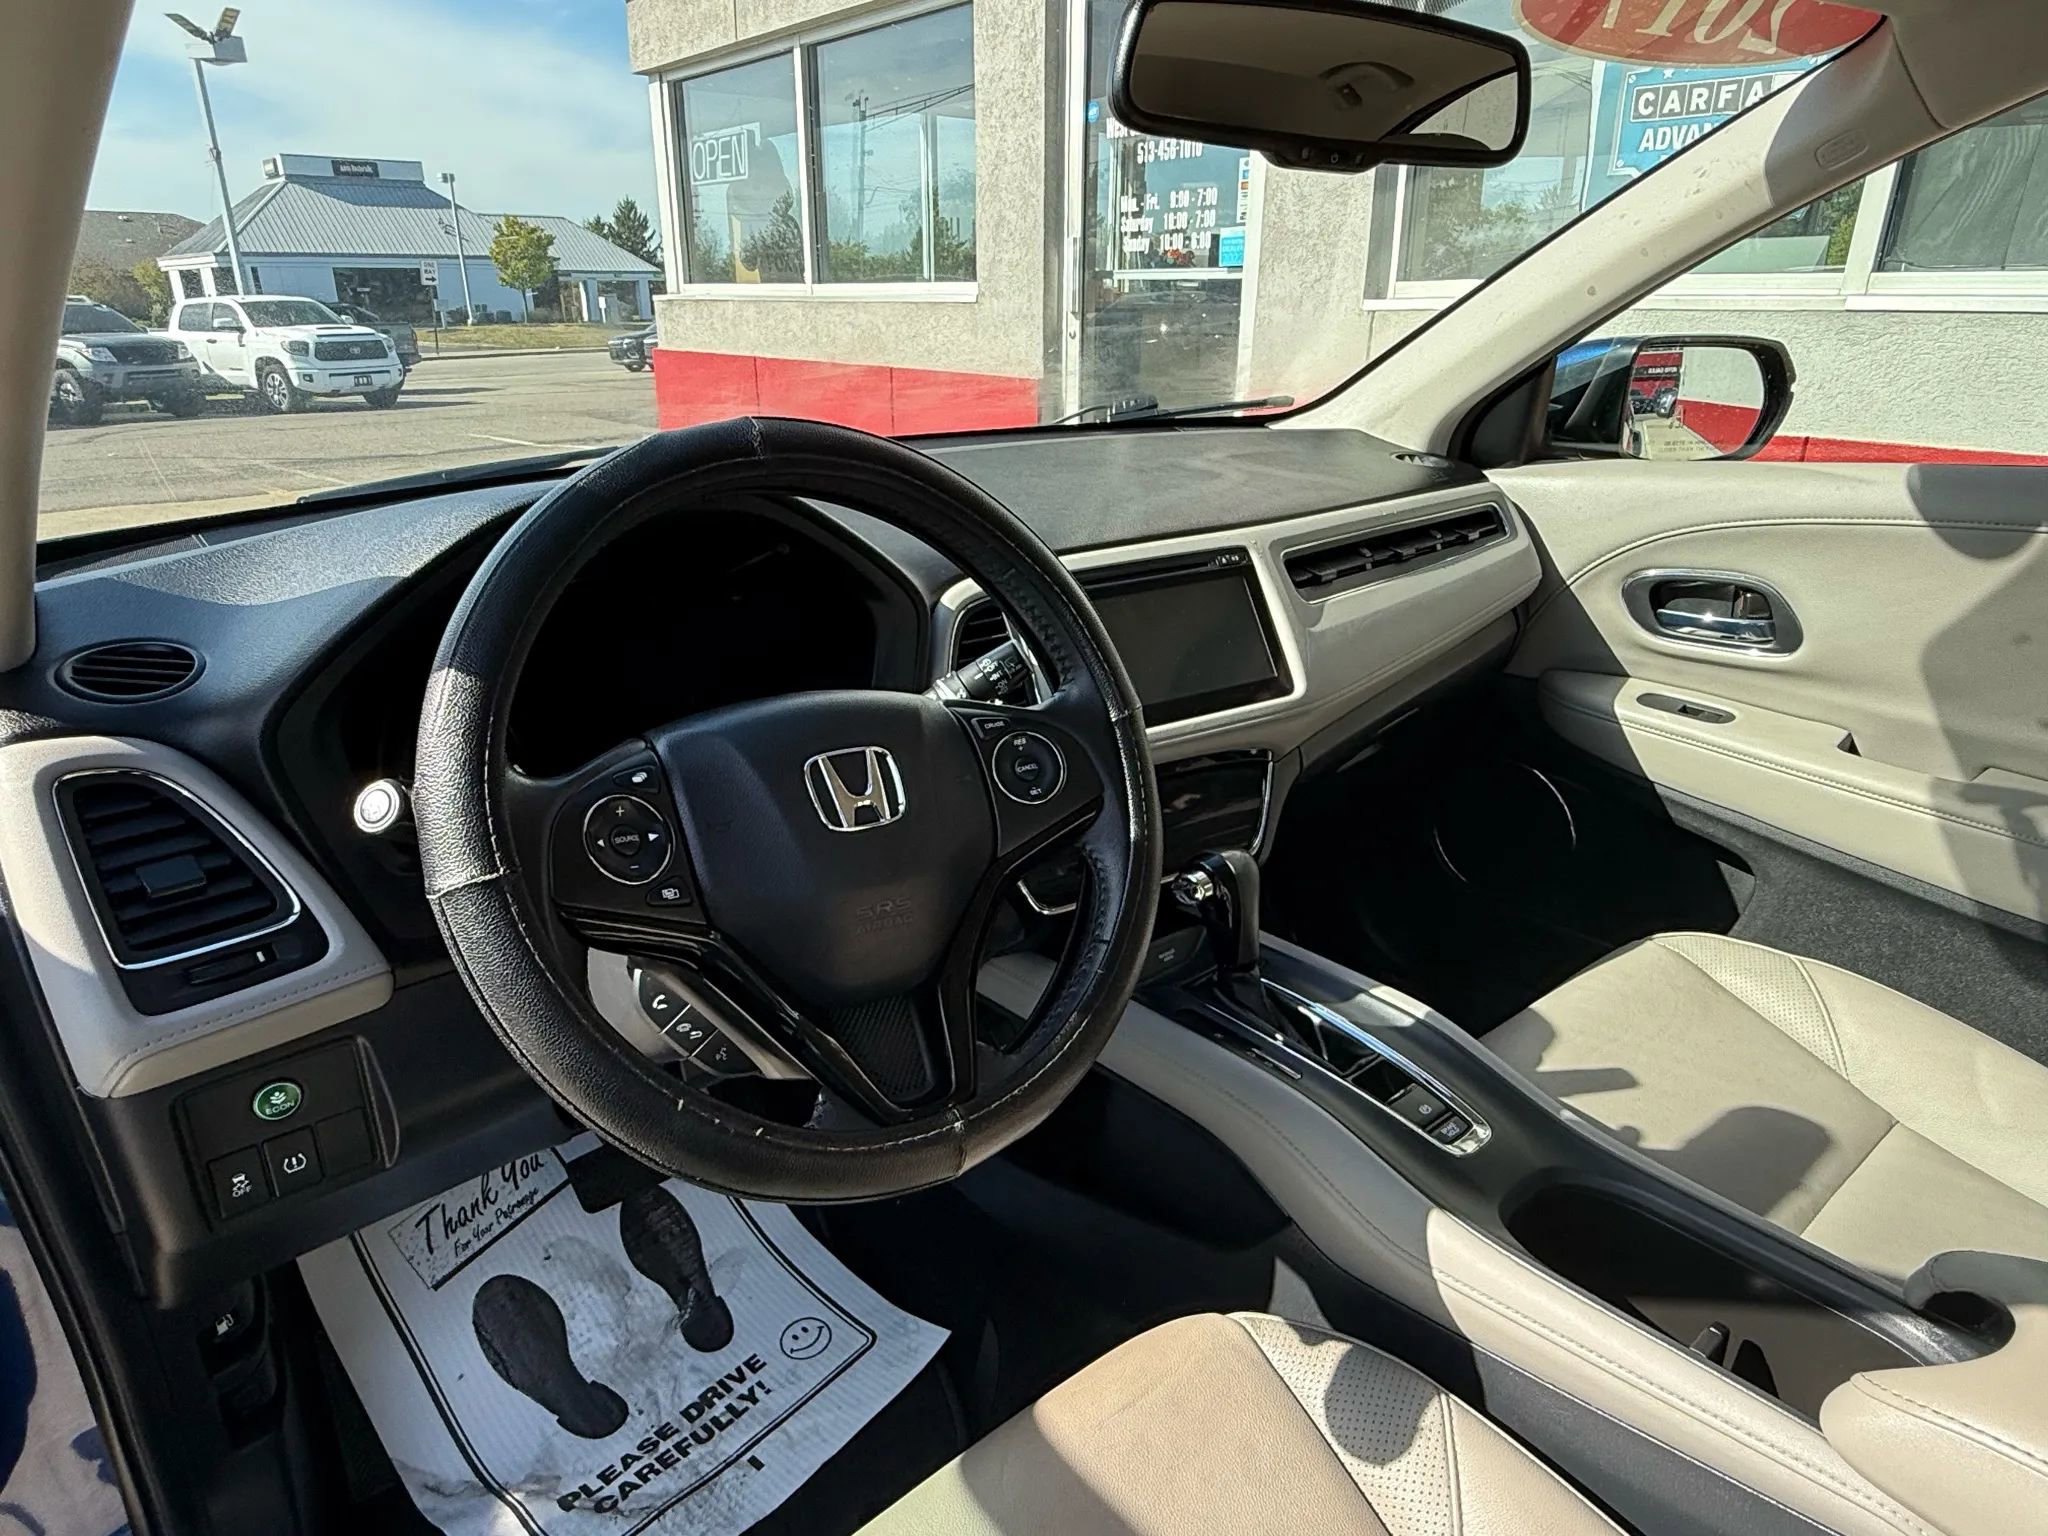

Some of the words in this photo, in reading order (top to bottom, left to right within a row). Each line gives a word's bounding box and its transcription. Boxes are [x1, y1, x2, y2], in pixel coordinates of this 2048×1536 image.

[1638, 80, 1766, 116] CARFA
[693, 133, 745, 180] OPEN
[1196, 187, 1218, 207] 7:00
[1164, 211, 1188, 230] 10:00
[1195, 209, 1216, 229] 7:00
[984, 720, 1006, 730] CRUISE
[1016, 762, 1039, 773] CANCEL
[614, 833, 641, 844] SOURCE
[265, 1100, 295, 1115] ECON
[231, 1184, 252, 1198] OFF
[415, 1171, 499, 1256] Thank
[501, 1153, 545, 1190] You
[454, 1238, 472, 1257] For
[472, 1221, 494, 1241] Your
[556, 1421, 680, 1513] PLEASE
[679, 1352, 768, 1424] DRIVE
[594, 1379, 773, 1513] CAREFULLY!
